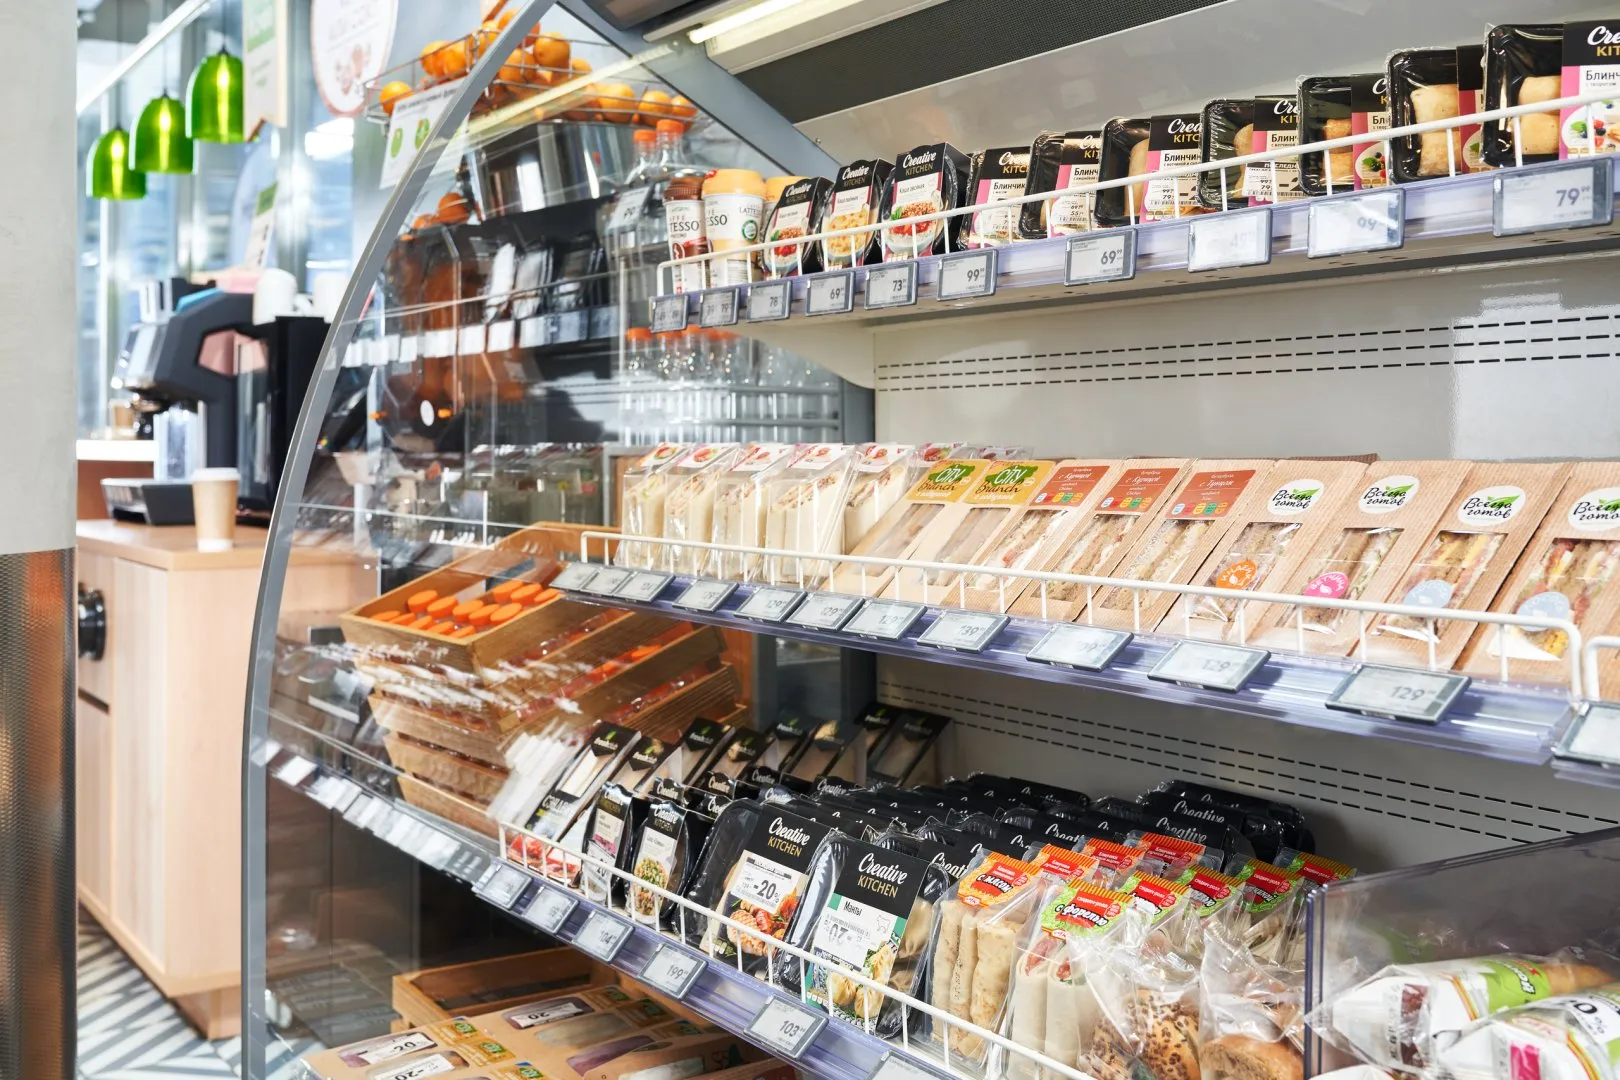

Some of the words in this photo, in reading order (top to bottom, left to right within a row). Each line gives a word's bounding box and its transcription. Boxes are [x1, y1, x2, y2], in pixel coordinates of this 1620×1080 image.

[902, 150, 937, 168] Creative
[842, 165, 870, 180] Creative
[905, 163, 934, 177] KITCHEN
[1556, 188, 1580, 207] 79
[1101, 251, 1116, 265] 69
[967, 268, 980, 282] 99
[1273, 489, 1312, 503] Всегда
[1364, 487, 1406, 501] Всегда
[1274, 499, 1311, 509] готов
[1366, 497, 1405, 507] готов
[1464, 497, 1512, 511] Всегда
[1467, 507, 1512, 518] готов
[1391, 686, 1425, 701] 129
[768, 817, 811, 846] Creative
[768, 836, 803, 857] KITCHEN
[858, 852, 908, 884] Creative
[857, 876, 898, 898] KITCHEN
[844, 901, 863, 916] Манты
[667, 962, 683, 980] 199
[779, 1019, 799, 1038] 103
